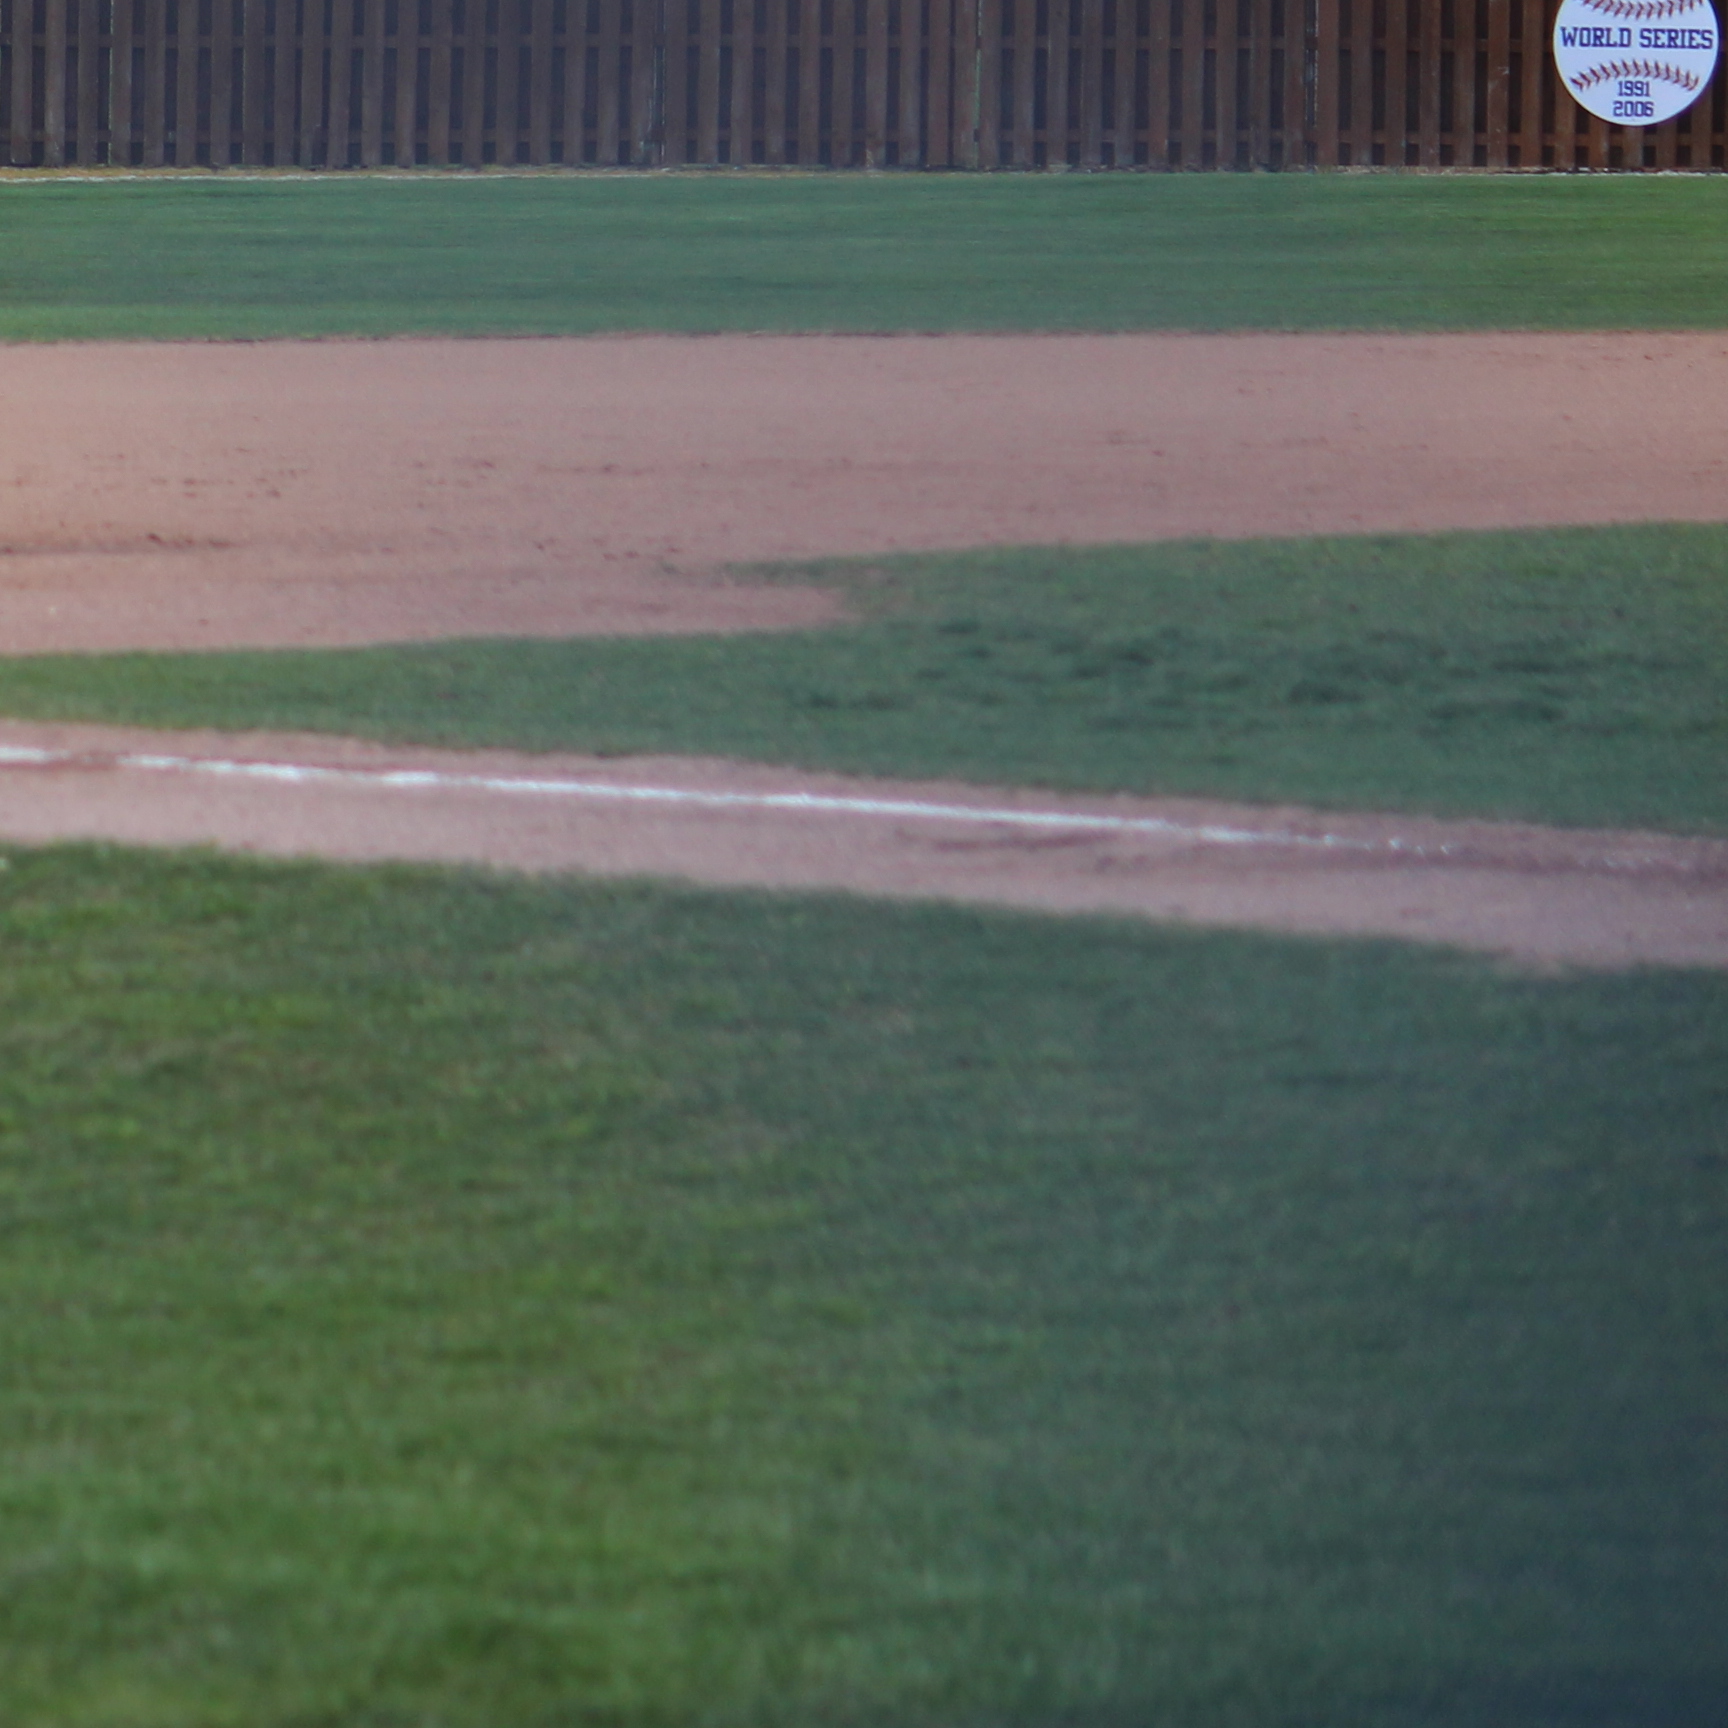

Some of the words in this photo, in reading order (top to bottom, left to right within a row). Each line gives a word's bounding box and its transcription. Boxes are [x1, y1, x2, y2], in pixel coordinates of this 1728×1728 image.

[1561, 26, 1632, 47] WORLD
[1639, 28, 1714, 49] SERIES
[1617, 80, 1651, 97] 1991
[1613, 101, 1654, 117] 2006
